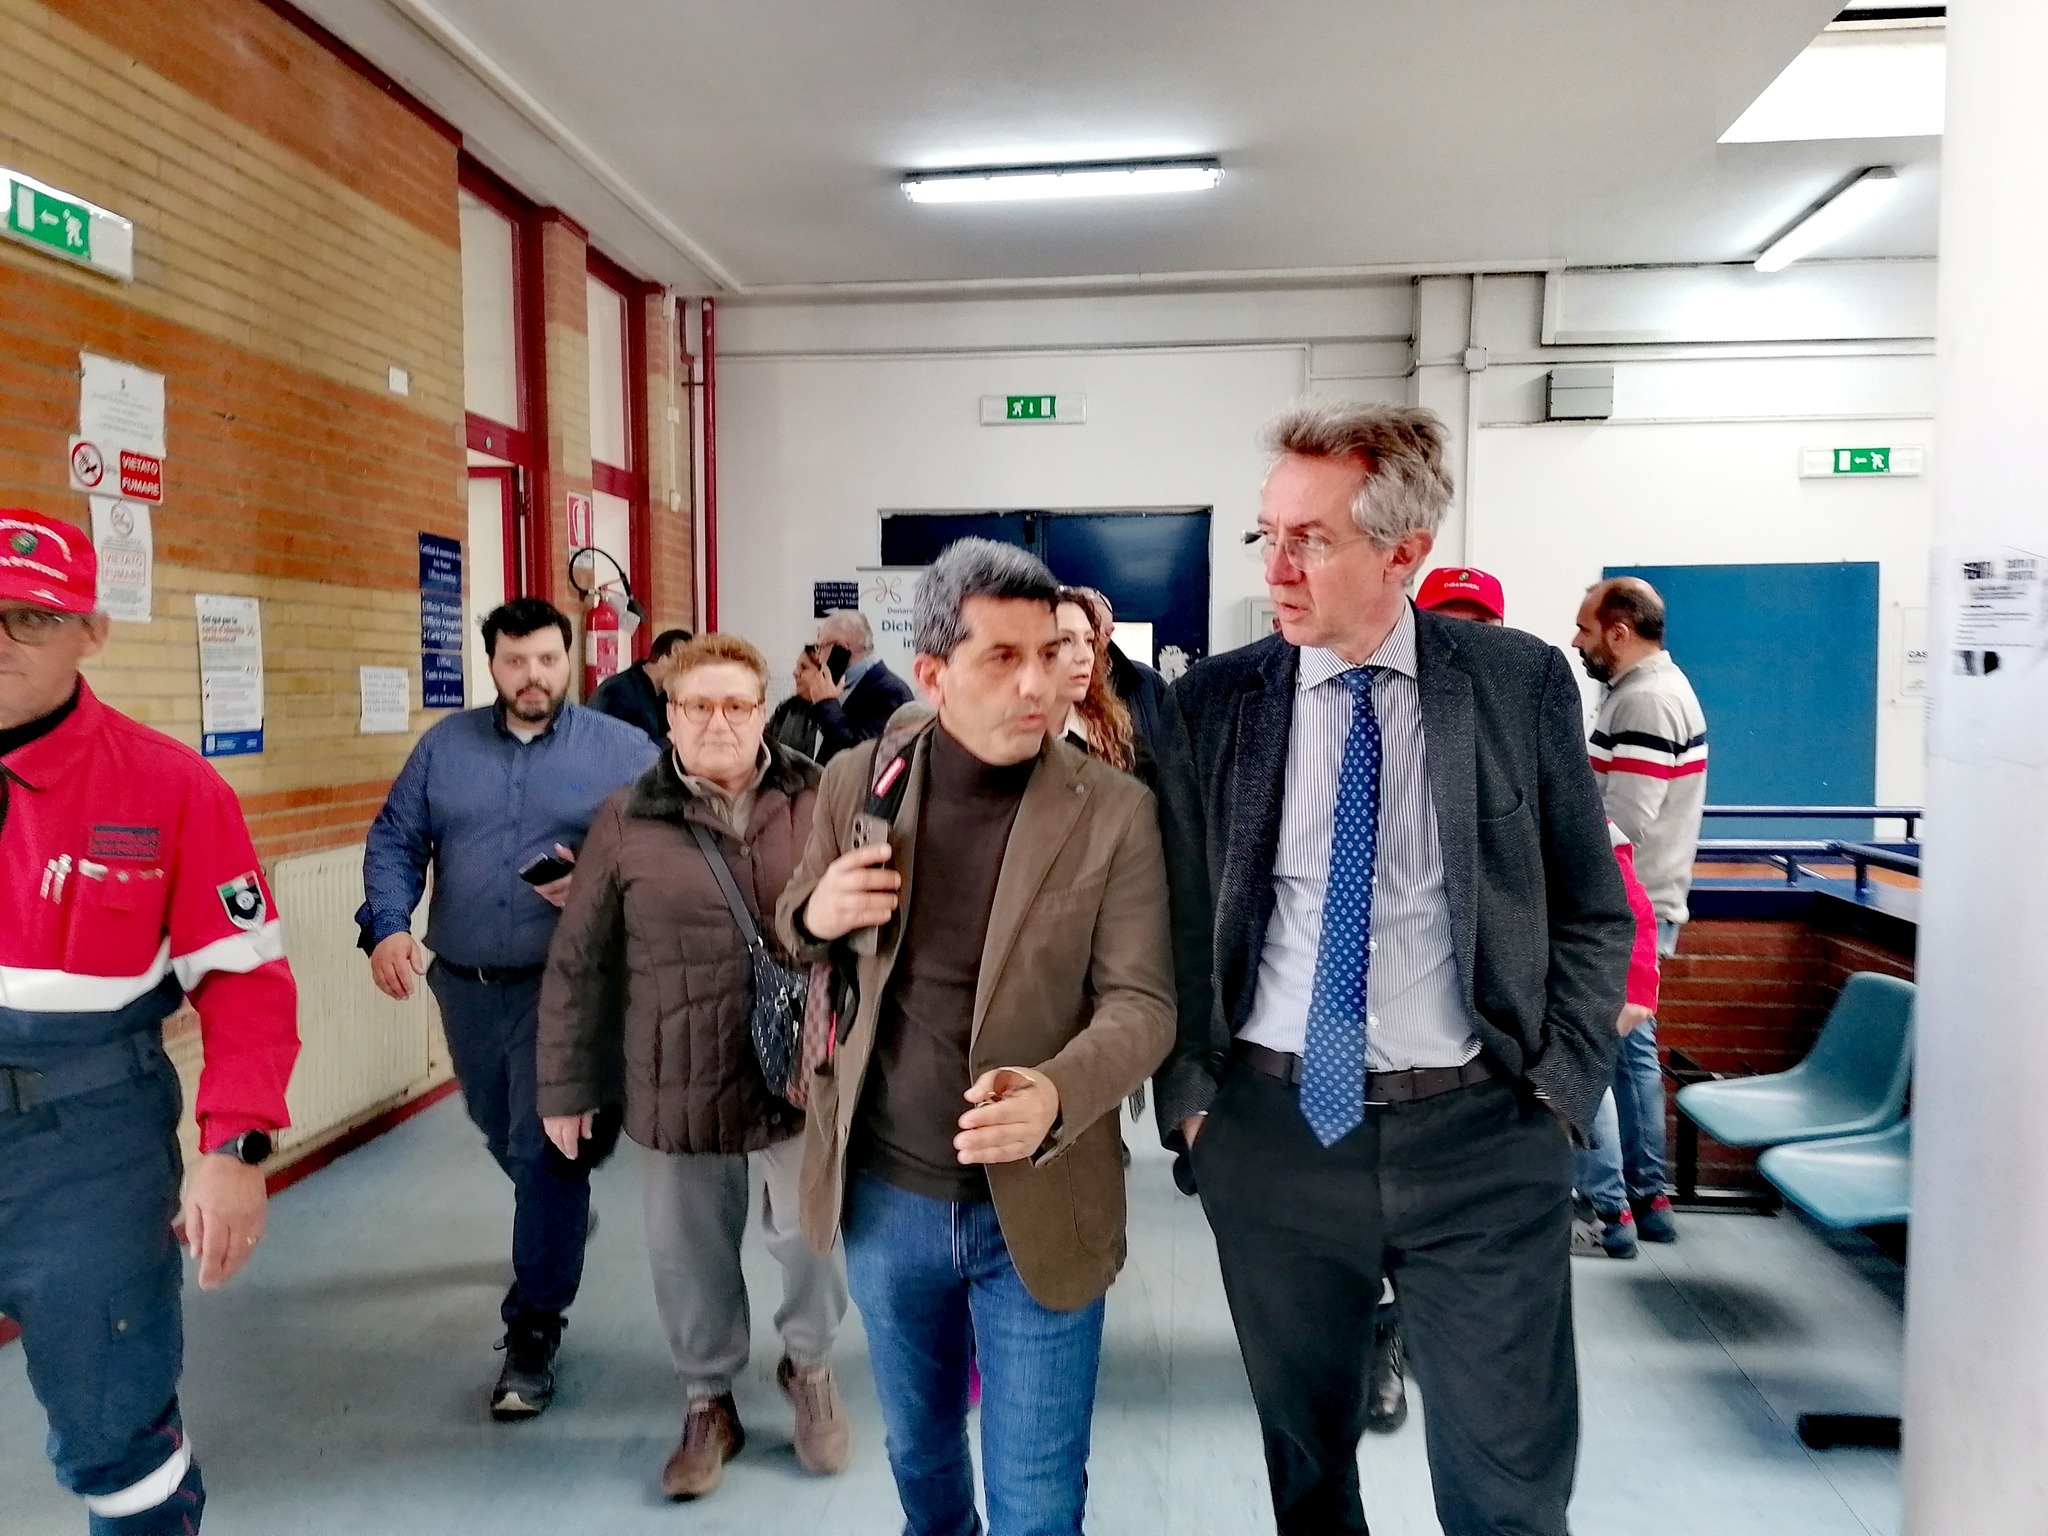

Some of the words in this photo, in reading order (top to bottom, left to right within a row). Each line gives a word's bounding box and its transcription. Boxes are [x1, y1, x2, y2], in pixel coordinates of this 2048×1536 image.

[122, 456, 158, 476] VIETATO
[121, 476, 160, 497] FUMARE
[882, 620, 912, 631] Dich
